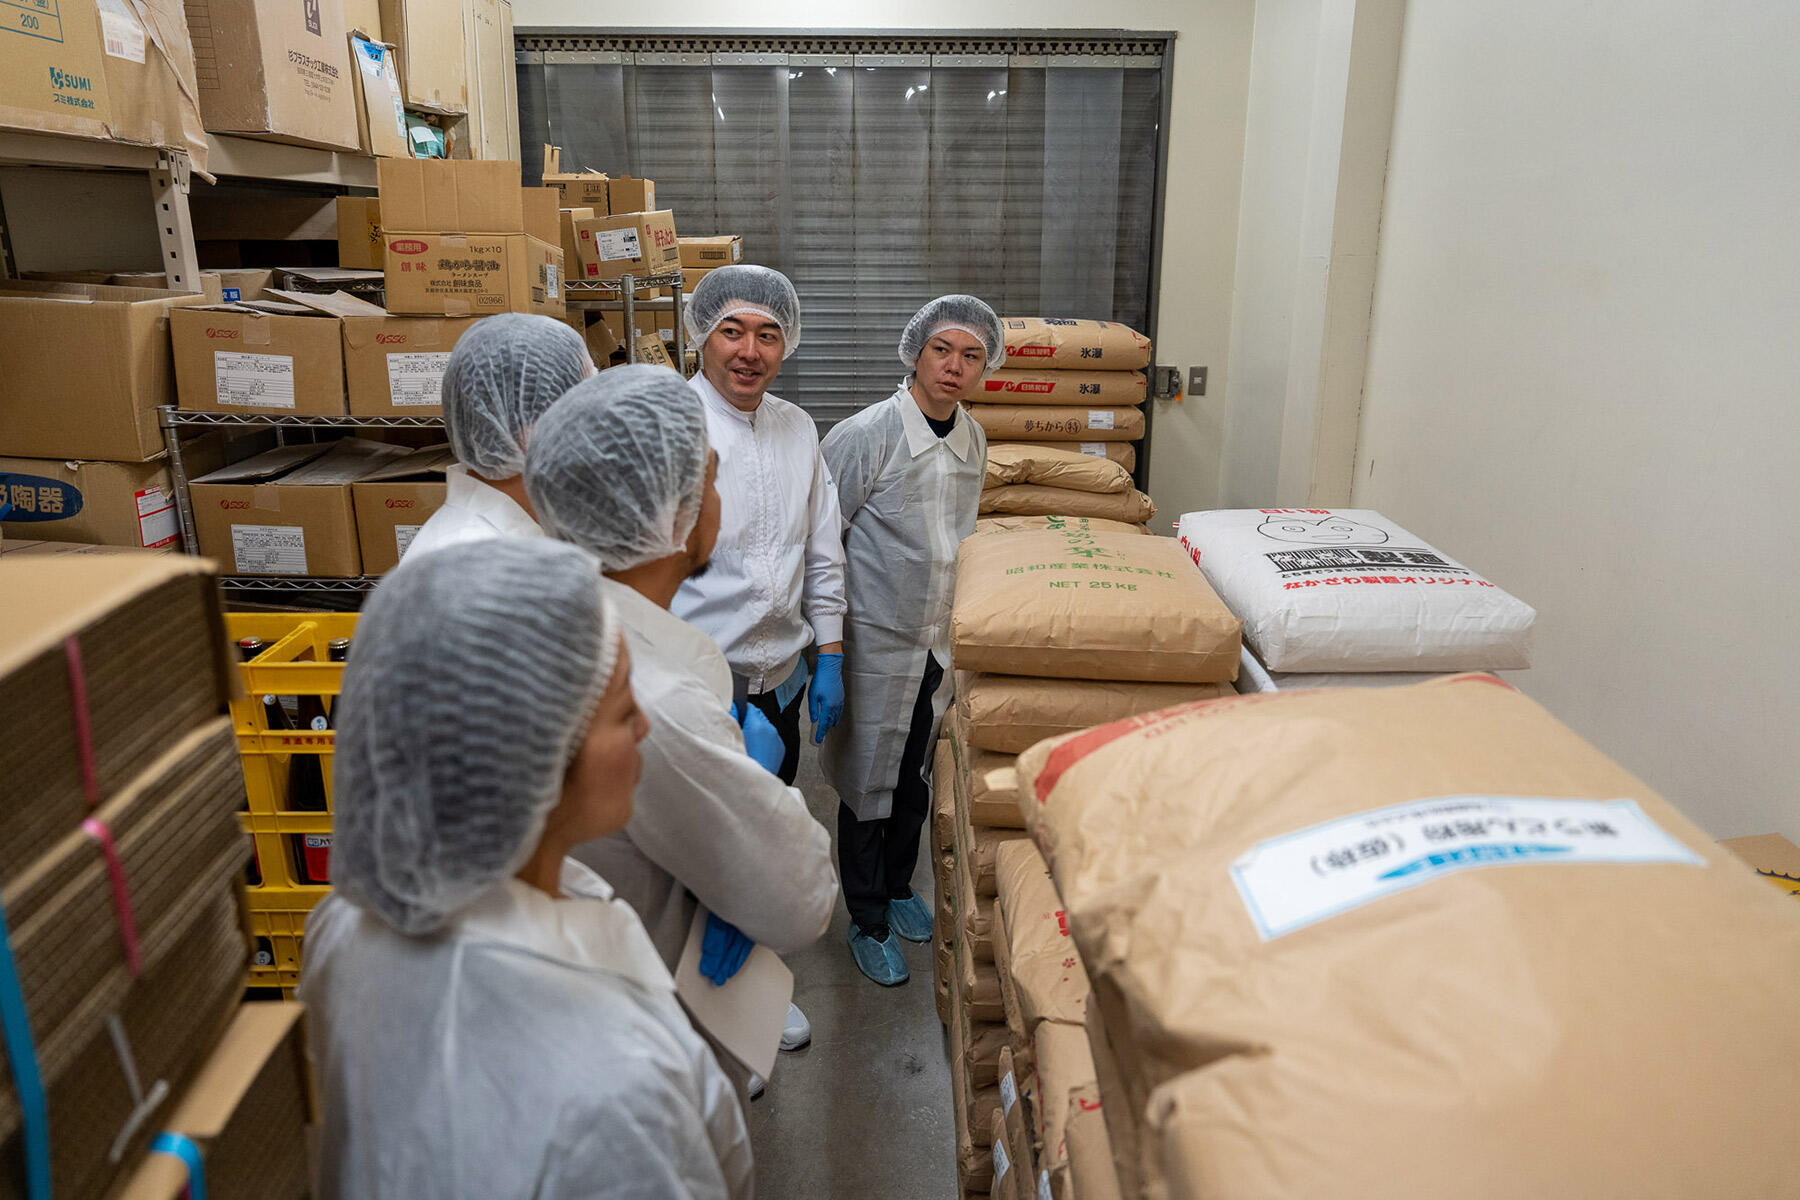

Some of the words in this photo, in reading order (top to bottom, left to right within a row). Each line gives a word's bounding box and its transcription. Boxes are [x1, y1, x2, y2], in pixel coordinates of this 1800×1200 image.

[20, 13, 39, 30] 200
[64, 74, 92, 91] SUMI
[53, 93, 95, 109] スミ株式会社
[1006, 562, 1176, 580] 昭和産業株式会社
[1049, 581, 1080, 589] NET
[1283, 576, 1496, 590] なかざわ製麺オリジナル
